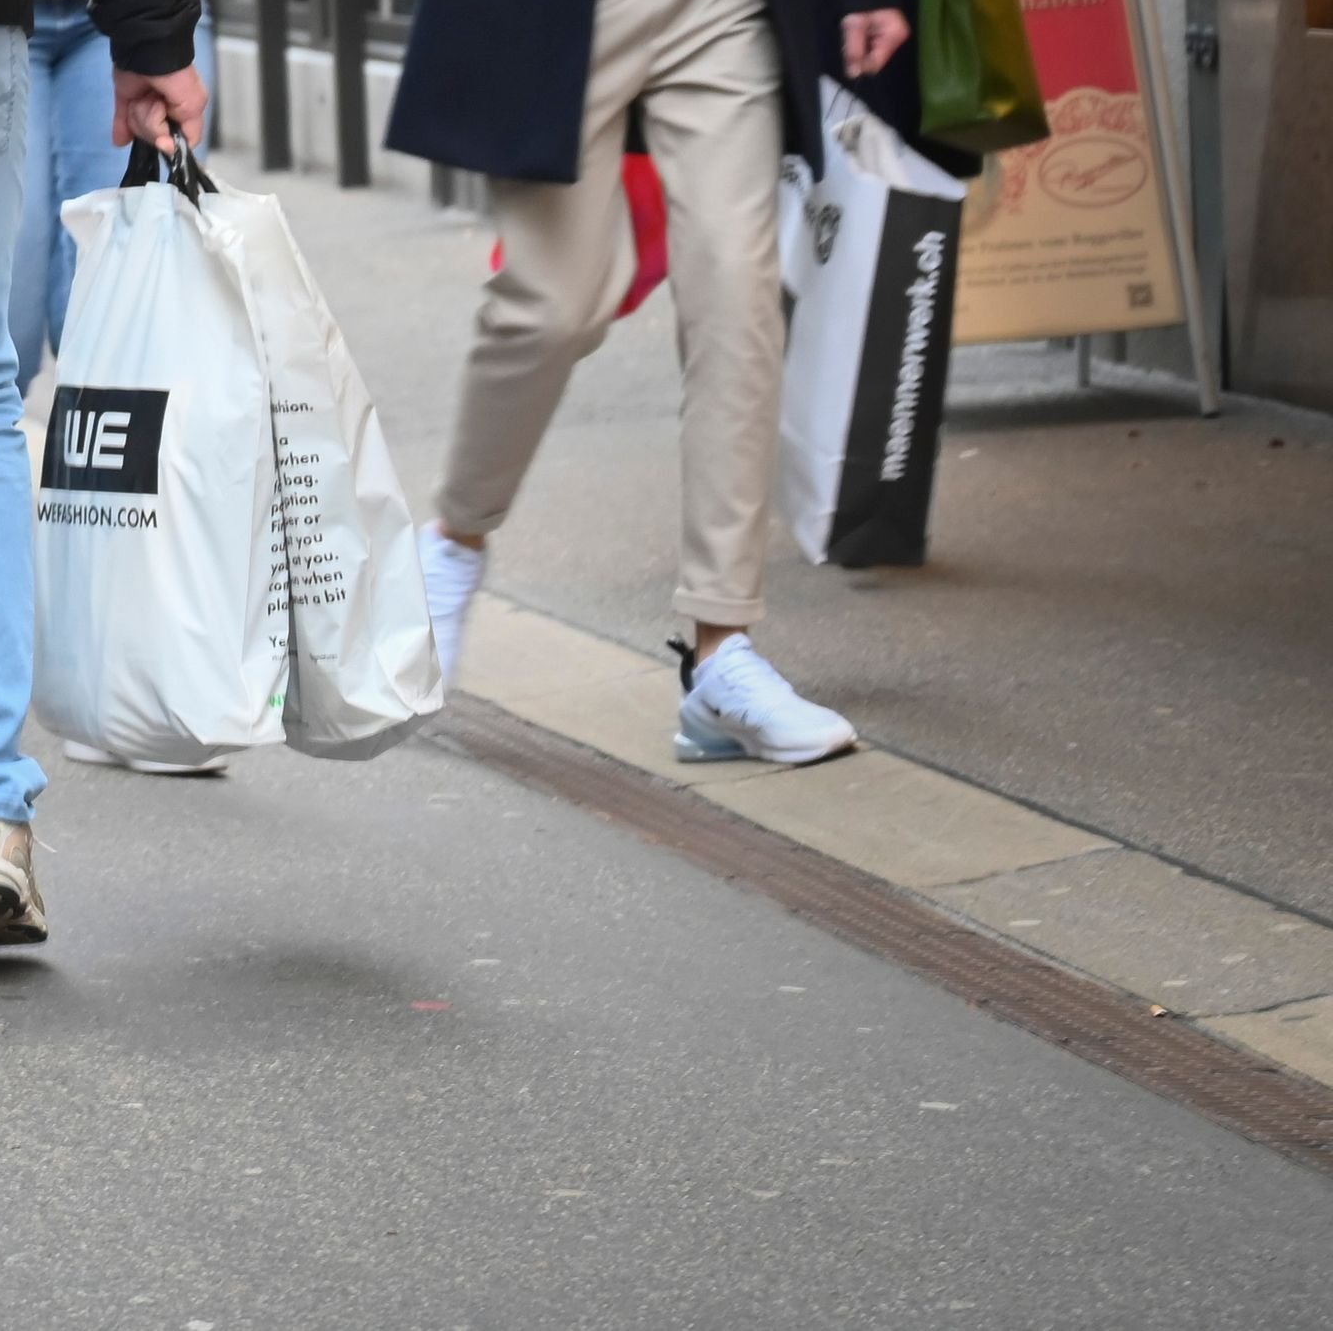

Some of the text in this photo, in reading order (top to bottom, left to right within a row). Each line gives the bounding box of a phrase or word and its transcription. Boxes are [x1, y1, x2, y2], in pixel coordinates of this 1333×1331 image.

[879, 230, 947, 482] maennerwerk.ch
[63, 409, 132, 470] WE
[279, 436, 289, 446] a
[283, 472, 319, 488] bag.
[37, 502, 158, 529] WEFASHION.COM
[303, 514, 321, 525] or
[295, 532, 323, 550] you
[304, 552, 339, 570] you.
[302, 570, 343, 586] when
[312, 595, 321, 604] a
[324, 588, 347, 604] bit
